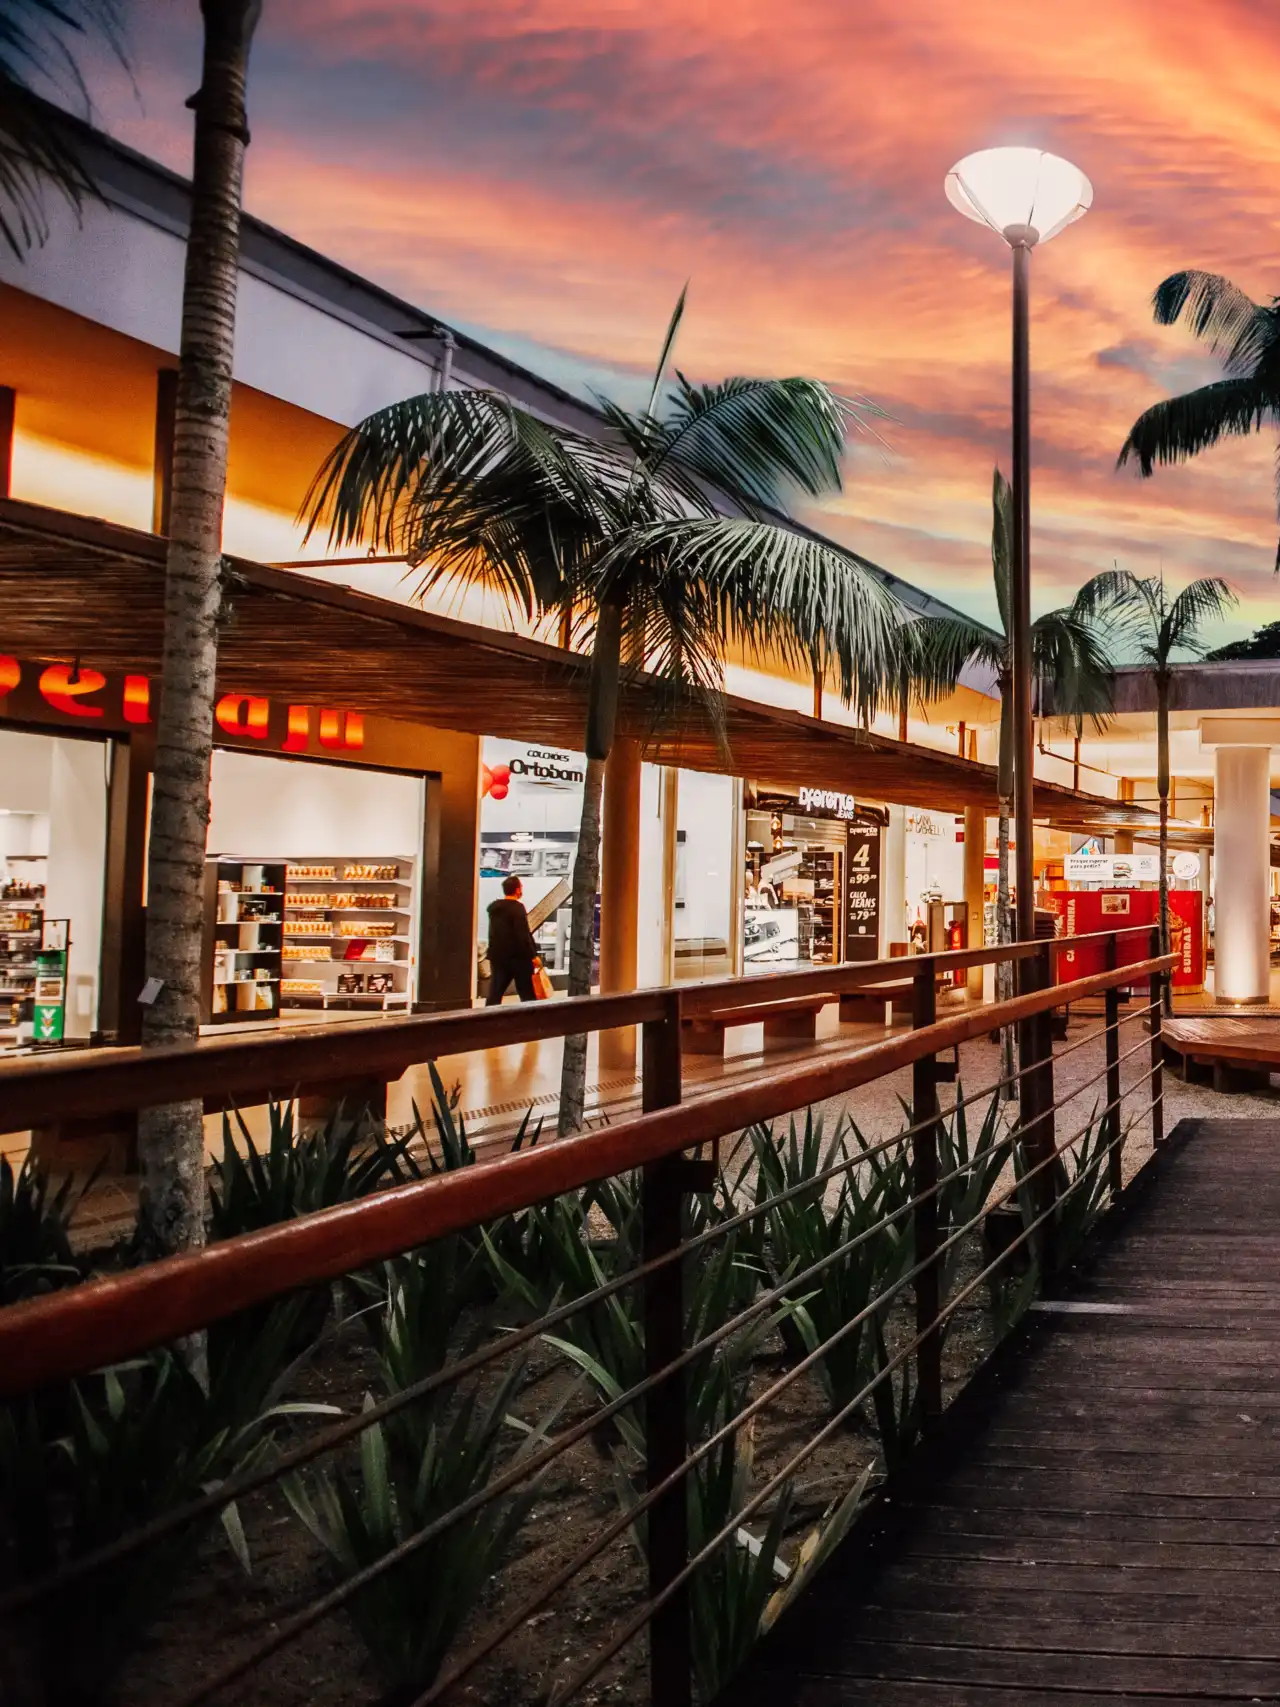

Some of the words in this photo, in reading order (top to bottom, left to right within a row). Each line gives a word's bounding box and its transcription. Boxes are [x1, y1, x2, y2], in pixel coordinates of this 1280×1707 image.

[509, 759, 583, 782] Ortobom
[853, 844, 870, 867] 4
[850, 898, 877, 908] JEANS
[1183, 926, 1192, 974] SUNDAE
